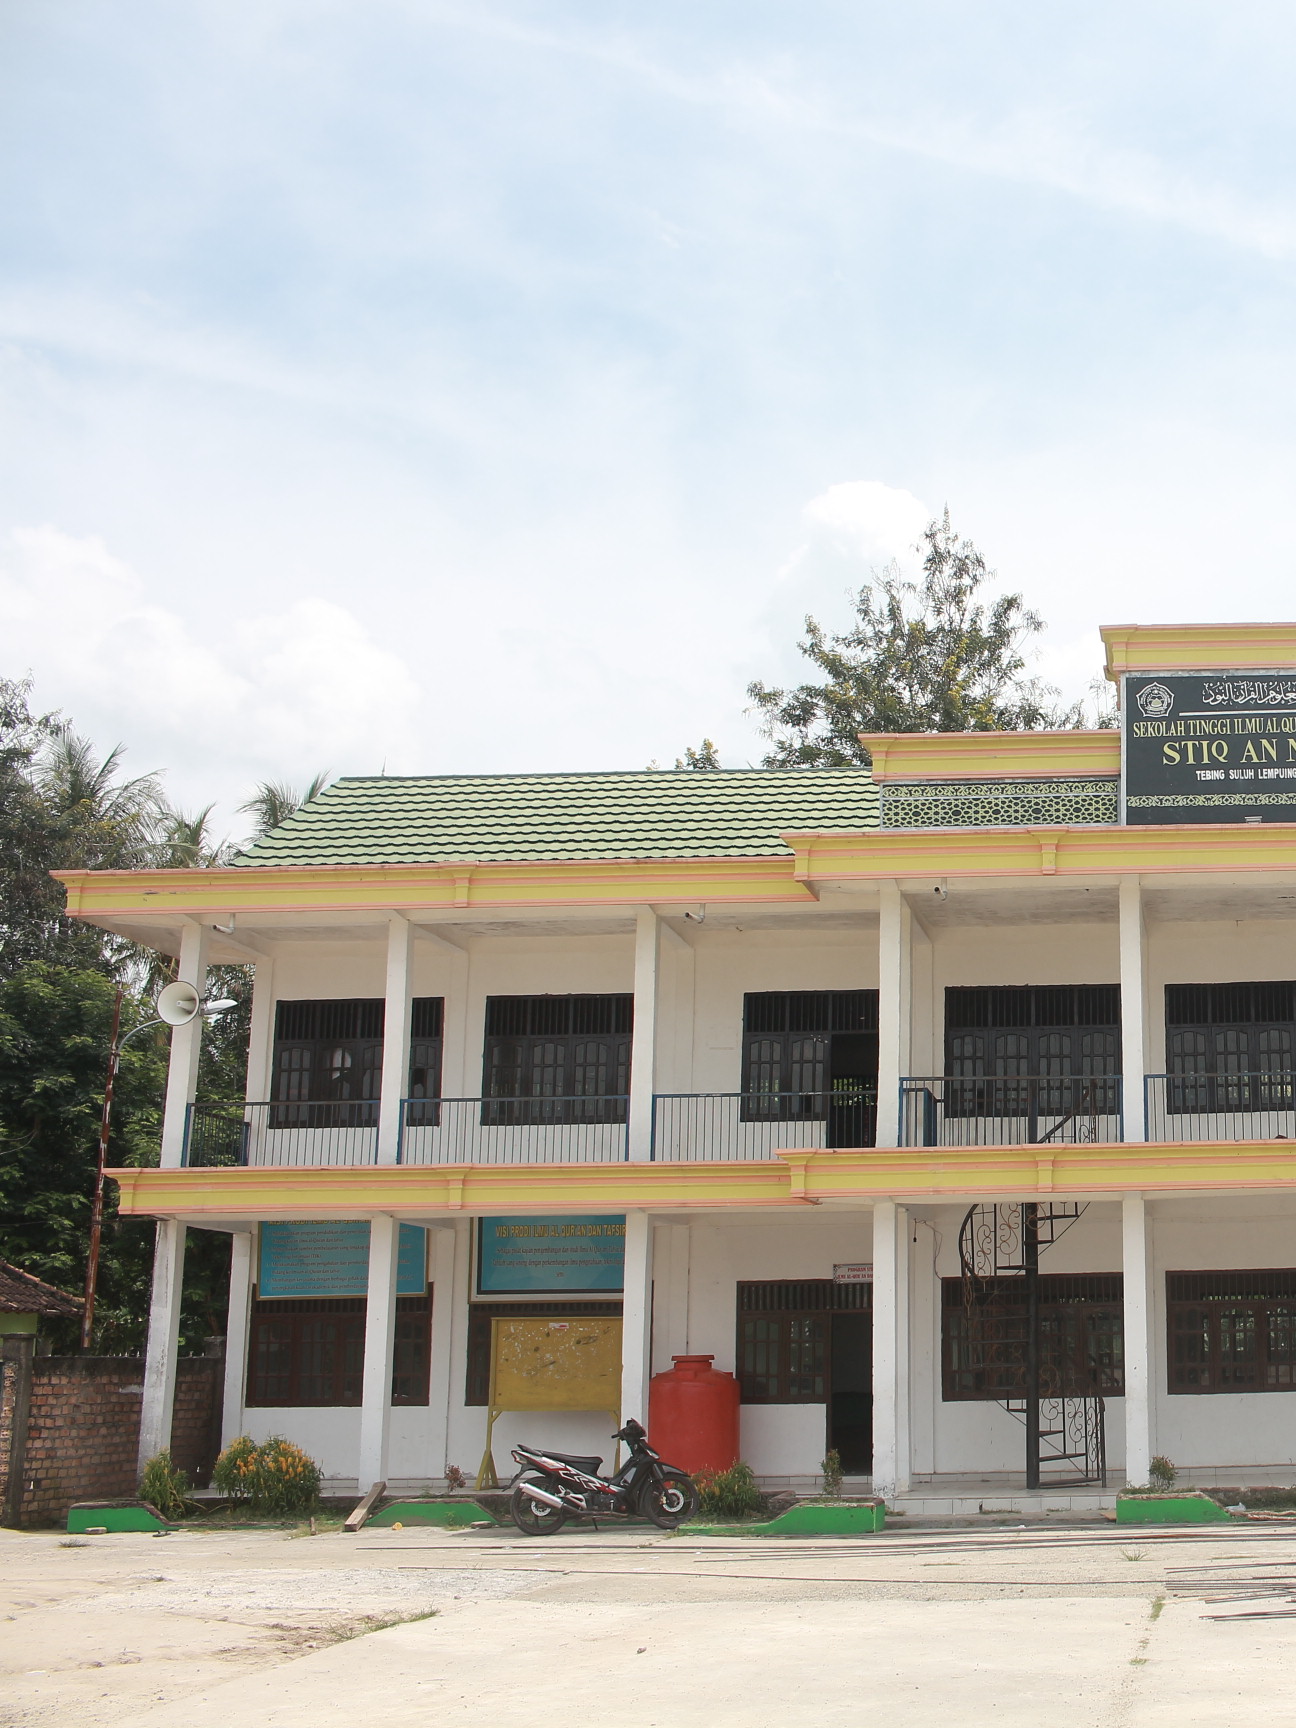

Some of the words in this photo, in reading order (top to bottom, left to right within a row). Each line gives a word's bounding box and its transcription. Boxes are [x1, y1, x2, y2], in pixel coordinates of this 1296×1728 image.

[1133, 720, 1185, 738] SEKOLAH
[1188, 719, 1231, 736] TINGGI
[1234, 717, 1264, 734] ILMU
[1265, 717, 1281, 734] AL
[1162, 740, 1229, 765] STIQ
[1240, 738, 1284, 763] AN
[1195, 769, 1225, 781] TEBING
[1229, 768, 1254, 780] SULUH
[495, 1225, 509, 1238] VISI
[511, 1225, 531, 1238] PRODI
[533, 1225, 548, 1237] ILMU
[550, 1225, 559, 1237] AL
[588, 1225, 602, 1237] DAN
